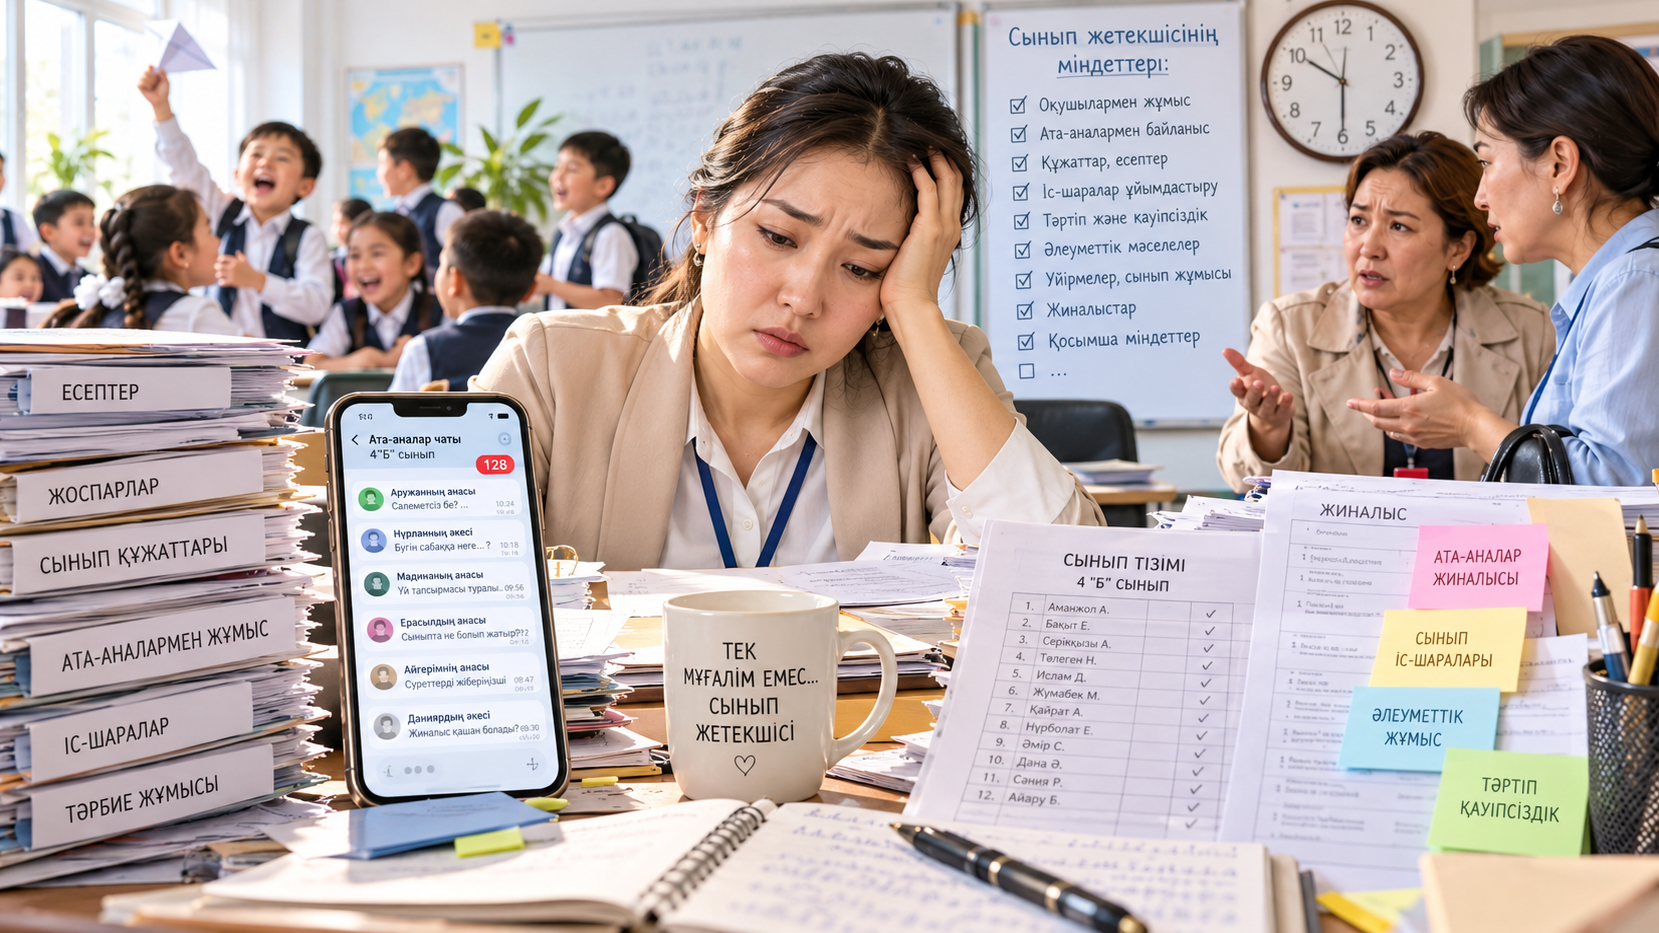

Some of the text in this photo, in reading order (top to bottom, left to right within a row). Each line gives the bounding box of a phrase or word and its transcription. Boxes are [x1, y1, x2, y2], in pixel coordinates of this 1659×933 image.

[1008, 23, 1219, 46] Сынып жетекшісінің
[1334, 18, 1352, 35] 12
[1367, 25, 1373, 41] 1
[1309, 27, 1323, 43] 11
[1289, 47, 1306, 63] 10
[1385, 44, 1396, 60] 2
[1057, 54, 1169, 78] міндеттері:
[1281, 75, 1292, 91] 9
[1393, 72, 1404, 88] 3
[1039, 95, 1191, 115] Оқушылармен жұмыс
[1290, 102, 1300, 118] 8
[1384, 100, 1396, 115] 4
[1040, 121, 1210, 143] Ата-аналармен байланыс
[1311, 121, 1322, 137] 7
[1337, 128, 1348, 144] 6
[1365, 120, 1376, 136] 5
[1041, 153, 1168, 174] Құжаттар, есептер
[1043, 181, 1218, 202] Іс-шаралар ұйымдастыру
[1043, 212, 1087, 231] Тәртіп
[1093, 213, 1127, 225] және
[1044, 239, 1200, 260] Әлеуметтік мәселелер
[1125, 270, 1169, 284] сынып
[1175, 268, 1232, 285] жұмысы
[1047, 302, 1136, 319] Жиналыстар
[1049, 330, 1200, 352] Қосымша міндеттер
[62, 383, 139, 401] ЕСЕПТЕР
[369, 434, 461, 446] Ата-аналар чаты
[398, 450, 435, 460] сынып
[483, 459, 508, 471] 128
[48, 478, 159, 505] ЖОСПАРЛАР
[447, 487, 476, 496] анасы
[1319, 503, 1408, 521] ЖИНАЛЫС
[40, 535, 228, 574] СЫНЫП ҚҰЖАТТАРЫ
[1063, 552, 1128, 570] СЫНЫП
[1433, 549, 1523, 564] АТА-АНАЛАР
[455, 571, 484, 580] анасы
[1076, 576, 1086, 589] 4
[1432, 571, 1519, 587] ЖИНАЛЫСЫ
[1025, 601, 1110, 615] 1. Аманжол А.
[457, 616, 486, 625] анасы
[1021, 618, 1091, 631] 2. Бақыт Е.
[61, 619, 269, 672] АТА-АНАЛАРМЕН ЖҰМЫС
[1018, 635, 1112, 649] 3. Серікқызы А.
[1415, 631, 1468, 646] СЫНЫП
[722, 642, 757, 660] ТЕК
[1015, 651, 1026, 662] 4.
[1085, 655, 1097, 666] Н.
[404, 663, 490, 676] Айгерімнің анасы
[1011, 668, 1087, 683] 5. Ислам Д.
[404, 677, 454, 690] Суреттерді
[1008, 685, 1101, 701] 6. Жумабек М.
[709, 697, 779, 715] СЫНЫП
[1004, 702, 1084, 717] 7. Қайрат А.
[407, 710, 491, 726] Даниярдың әкесі
[1371, 707, 1464, 724] ӘЛЕУМЕТТІК
[64, 717, 169, 755] ІС-ШАРАЛАР
[409, 728, 451, 738] Жиналыс
[999, 720, 1010, 730] 8.
[1083, 725, 1094, 736] Е.
[995, 737, 1065, 752] 9. Әмір С.
[1384, 731, 1442, 748] ЖҰМЫС
[988, 754, 1063, 770] 10. Дана Ә.
[983, 772, 1064, 788] 11. Сәния Р.
[1481, 777, 1538, 795] ТӘРТІП
[65, 774, 219, 823] ТӘРБИЕ ЖҰМЫСЫ
[977, 789, 995, 801] 12.
[1007, 792, 1047, 807] Айару
